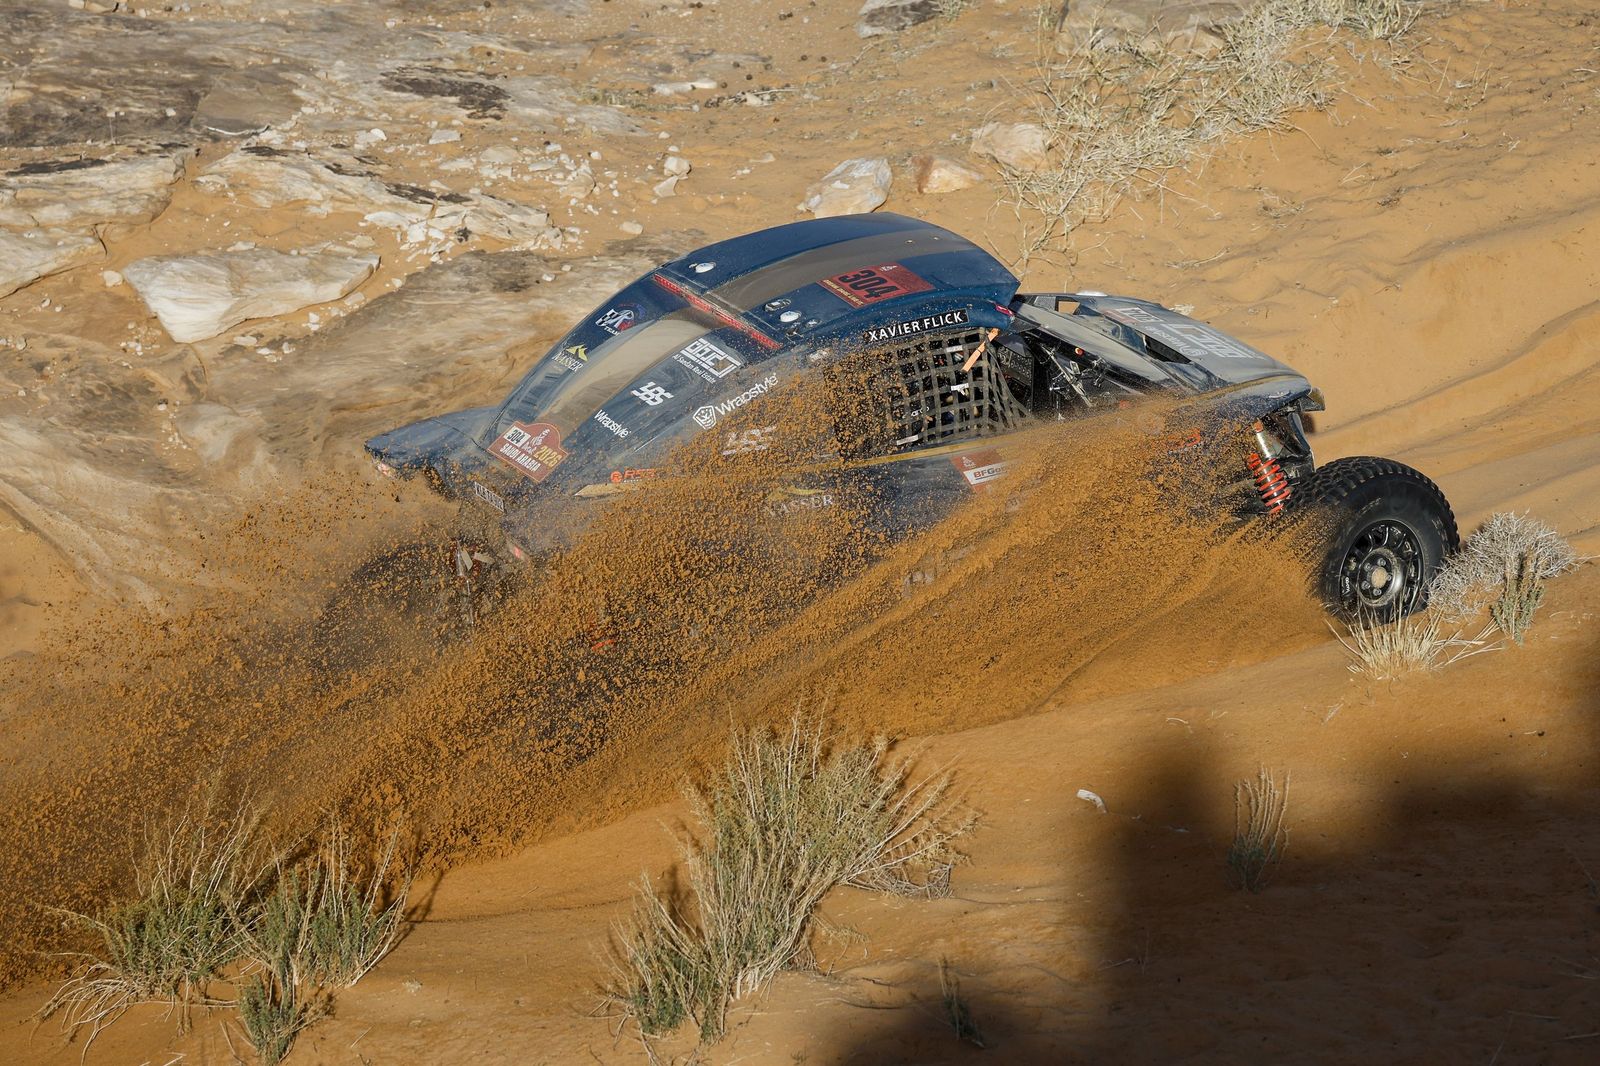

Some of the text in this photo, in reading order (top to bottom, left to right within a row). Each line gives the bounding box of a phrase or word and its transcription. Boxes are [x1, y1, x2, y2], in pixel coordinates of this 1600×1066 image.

[838, 270, 899, 298] 304
[868, 311, 963, 341] XAVIER FLICK
[552, 352, 583, 371] NASSER
[692, 366, 705, 376] Real
[701, 371, 716, 384] Estate
[715, 373, 778, 416] Wrapstyle
[507, 429, 526, 444] 304
[594, 409, 632, 438] Wrapstyle
[500, 443, 521, 459] SAUDI
[515, 453, 541, 472] ARABIA
[534, 445, 562, 468] 2026
